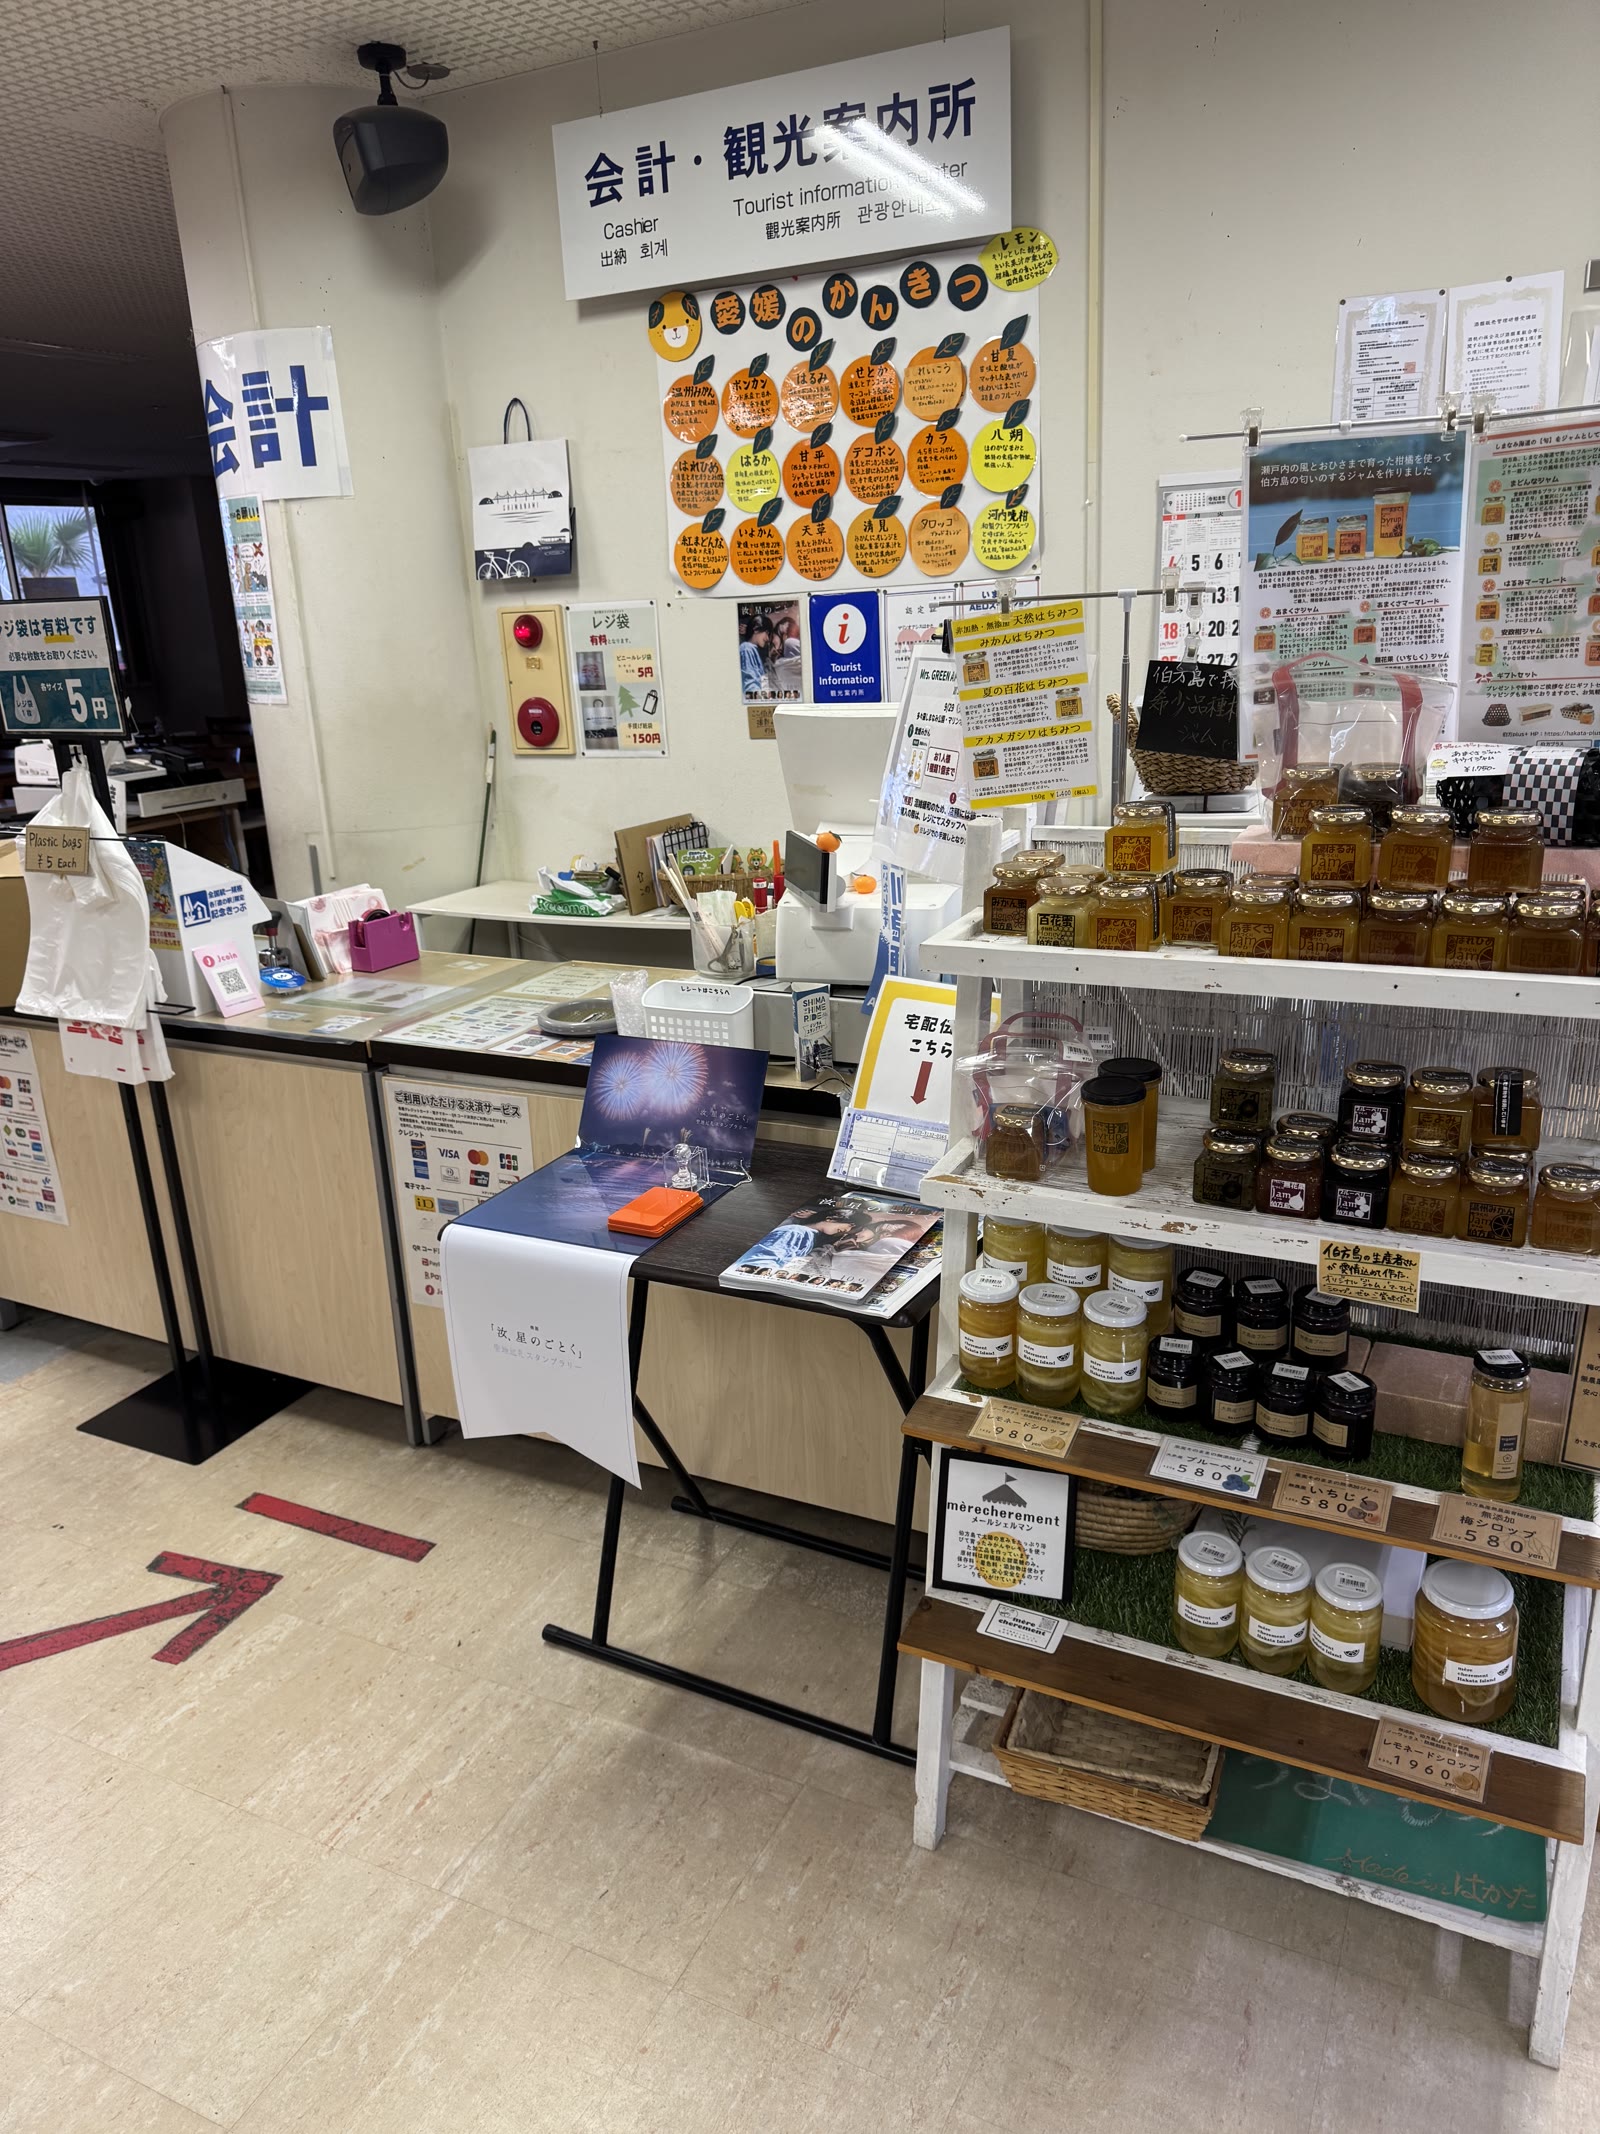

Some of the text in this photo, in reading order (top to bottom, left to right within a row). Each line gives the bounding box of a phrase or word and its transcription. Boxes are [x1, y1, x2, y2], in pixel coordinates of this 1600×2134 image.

[584, 78, 976, 208] 会計・観光案内所
[733, 190, 794, 216] Tourist
[604, 216, 659, 240] Cashier
[1000, 232, 1039, 250] レモン
[600, 239, 668, 267] 出納 회계
[1510, 476, 1559, 487] まどんなジャム
[1192, 553, 1223, 571] 5 6
[592, 613, 630, 629] レジ袋
[1014, 607, 1078, 626] 天然はちみつ
[0, 616, 96, 638] ジ袋は有料です
[1163, 620, 1225, 639] 18 20
[980, 628, 1055, 648] みかんはちみつ
[638, 667, 653, 677] 5円
[831, 662, 862, 672] Tourist
[819, 675, 874, 685] Information
[982, 678, 1069, 698] 夏の百花はちみつ
[632, 733, 661, 744] 150円
[975, 725, 1081, 746] アカメガシワはちみつ
[29, 832, 83, 850] Plastic bags
[58, 858, 77, 868] Each
[394, 1091, 522, 1118] ご利用いただける決済サービス
[437, 1147, 460, 1160] VISA
[987, 1414, 1068, 1435] レモネードシロップ
[996, 1426, 1033, 1442] 980
[1177, 1464, 1222, 1480] 580
[1187, 1456, 1254, 1474] ブルーベリー
[1300, 1496, 1347, 1513] 580
[1310, 1486, 1368, 1505] いちじく
[947, 1501, 1060, 1526] mèrecherement
[1481, 1511, 1515, 1524] 無添加
[1460, 1515, 1537, 1538] 梅シロップ
[1464, 1529, 1523, 1553] 580
[1383, 1738, 1480, 1771] レモネードシロップ
[1394, 1755, 1450, 1780] 1960
